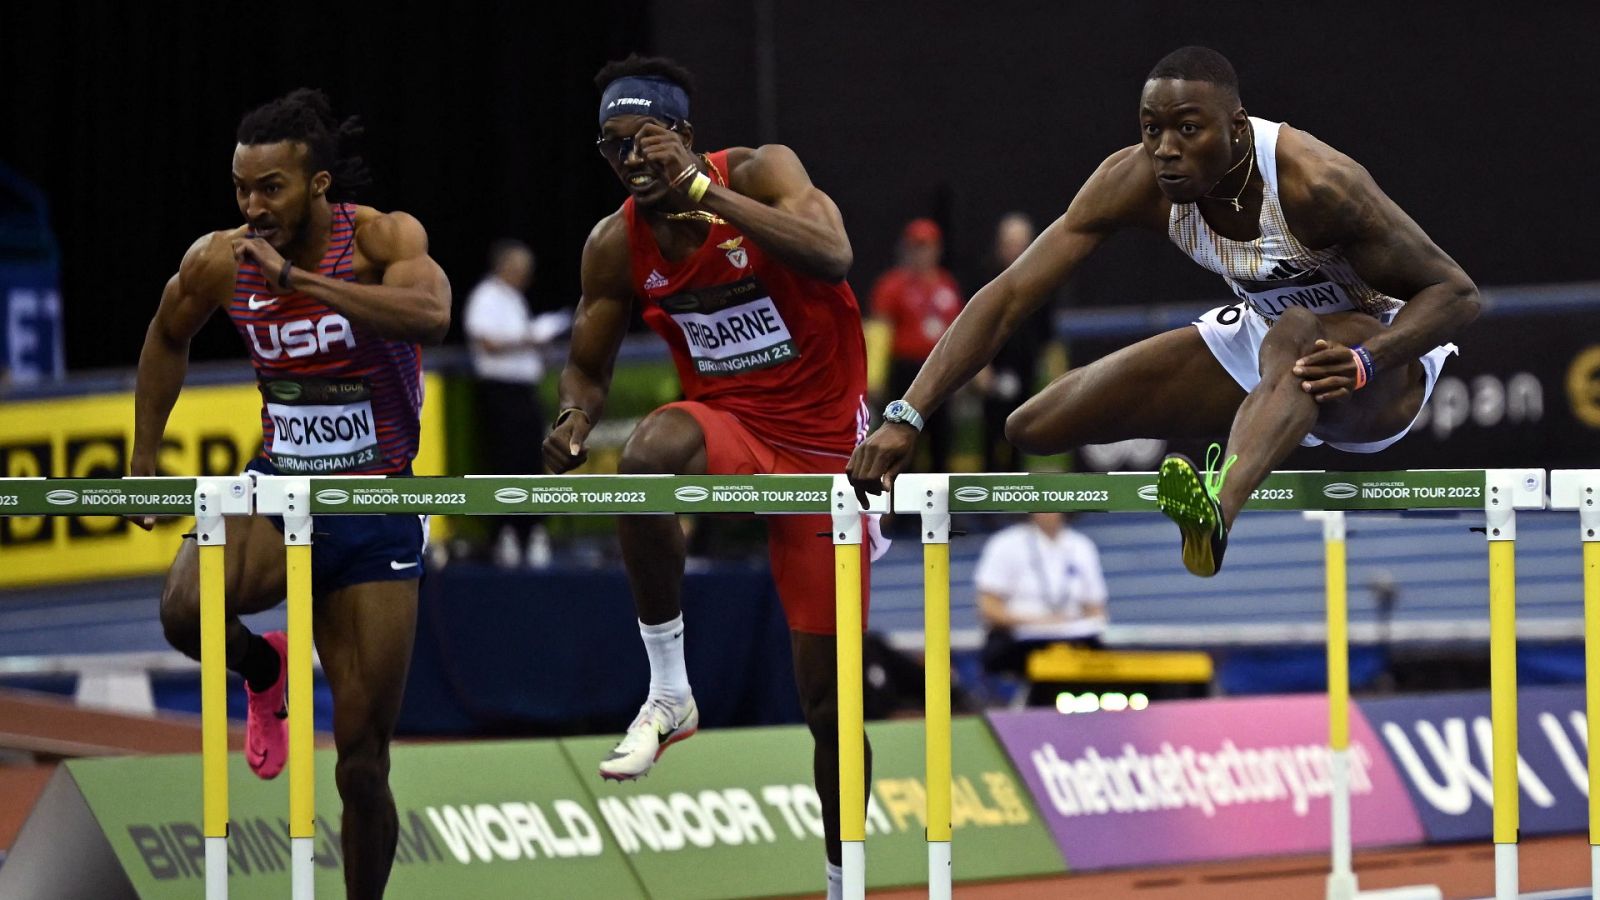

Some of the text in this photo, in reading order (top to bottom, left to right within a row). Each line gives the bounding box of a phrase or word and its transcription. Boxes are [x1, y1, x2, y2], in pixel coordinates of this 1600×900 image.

[616, 97, 652, 107] TERREX
[644, 279, 669, 290] adidas
[682, 307, 780, 350] IRIBARNE
[246, 313, 356, 360] USA
[698, 344, 791, 372] BIRMINGHAM 23
[273, 409, 369, 444] DICKSON
[276, 449, 374, 471] BIRMINGHAM 23
[353, 493, 466, 504] INDOOR TOUR 2023
[532, 492, 646, 503] INDOOR TOUR 2023
[712, 491, 827, 502] INDOOR TOUR 2023
[992, 490, 1108, 502] INDOOR TOUR 2023
[1261, 489, 1294, 500] 2023
[1362, 487, 1480, 499] INDOOR TOUR 2023
[82, 494, 192, 505] INDOOR TOUR 2023
[425, 798, 603, 865] WORLD
[597, 787, 777, 854] INDOOR
[763, 783, 892, 840] TO
